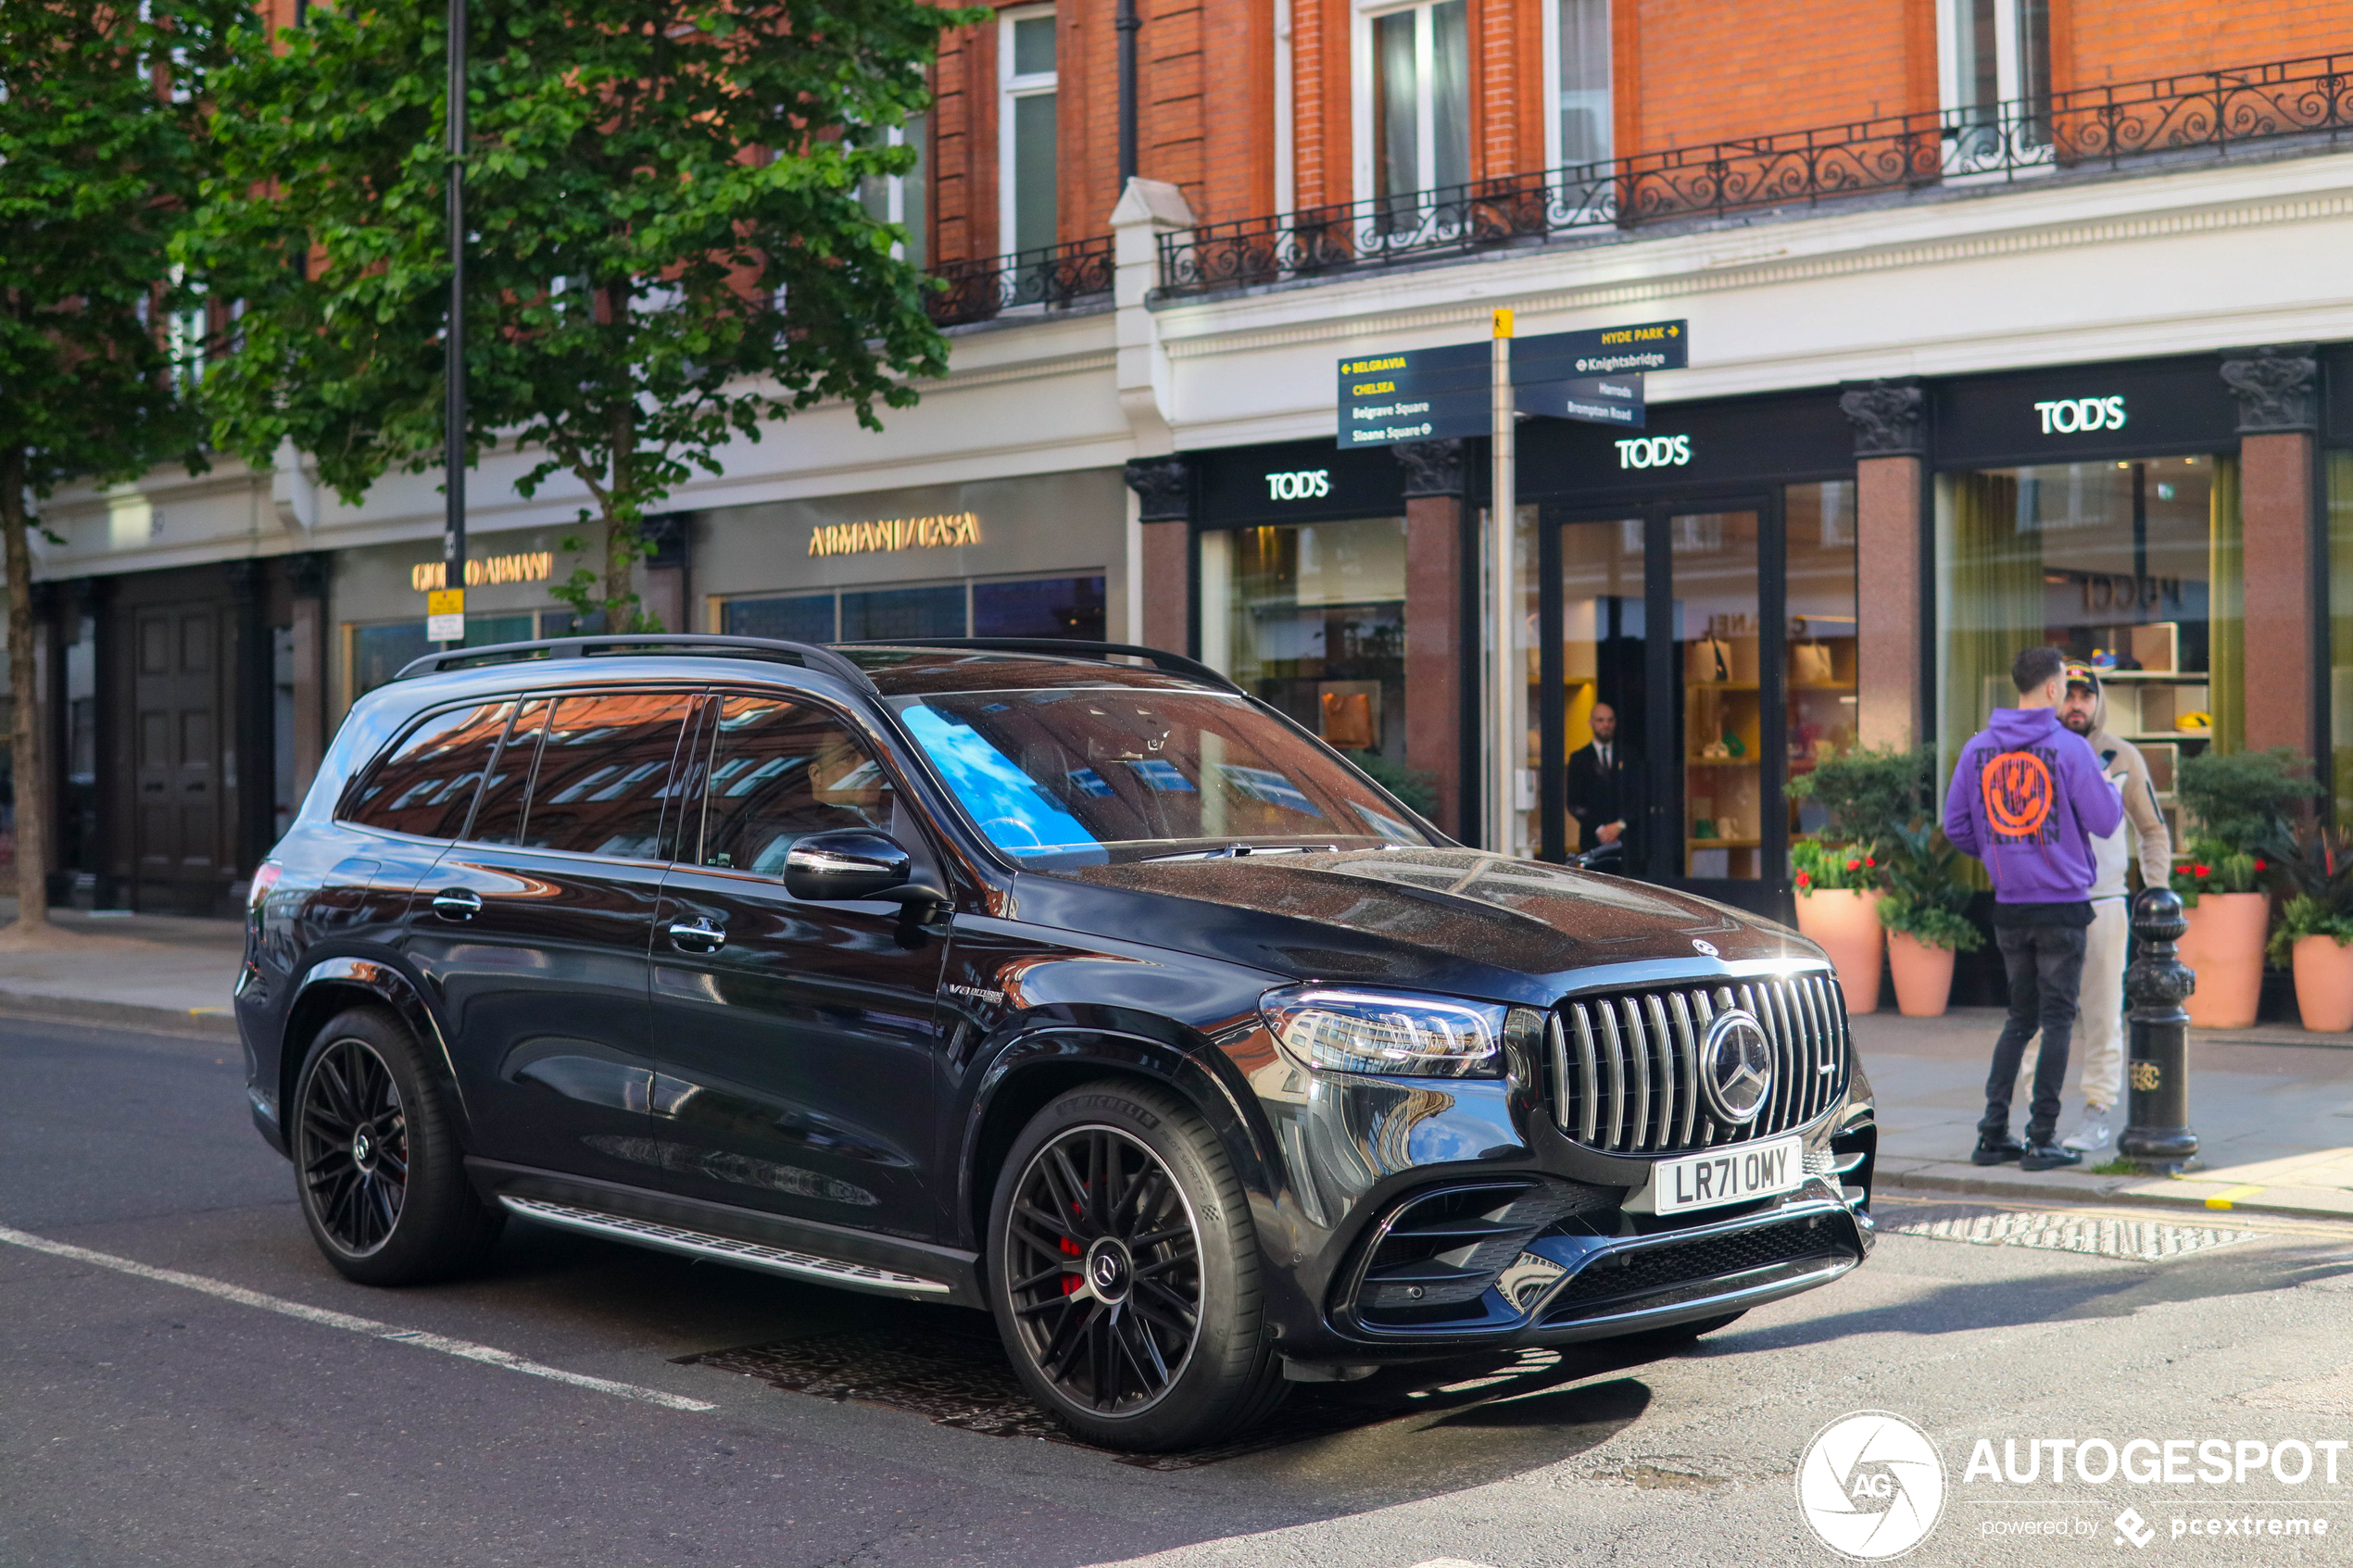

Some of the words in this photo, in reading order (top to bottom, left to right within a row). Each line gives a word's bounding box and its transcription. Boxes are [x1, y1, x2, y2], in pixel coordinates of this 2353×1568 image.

[1602, 331, 1632, 345] HYDE
[1634, 327, 1665, 341] PARK
[1353, 358, 1406, 373] BELGRAVIA
[1588, 353, 1666, 371] Knightsbridge
[1353, 382, 1395, 395] CHELSEA
[1599, 383, 1631, 398] Harrods
[1353, 407, 1393, 420] Belgrave
[1395, 402, 1429, 416] Square
[1567, 400, 1609, 418] Brompton
[1610, 407, 1631, 421] Road
[2034, 395, 2126, 434] TOD'S
[1353, 430, 1385, 442] Sloane
[1387, 426, 1420, 440] Square
[1615, 434, 1691, 469] TOD'S
[1265, 469, 1329, 500] TOD'S
[484, 551, 552, 584] ARMANI
[950, 984, 970, 996] V8
[1076, 1096, 1156, 1127] MICHELIN
[1160, 1130, 1182, 1152] PILOT
[1179, 1154, 1202, 1185] SPORT
[1676, 1157, 1737, 1204] LR71
[1745, 1147, 1788, 1191] OMY
